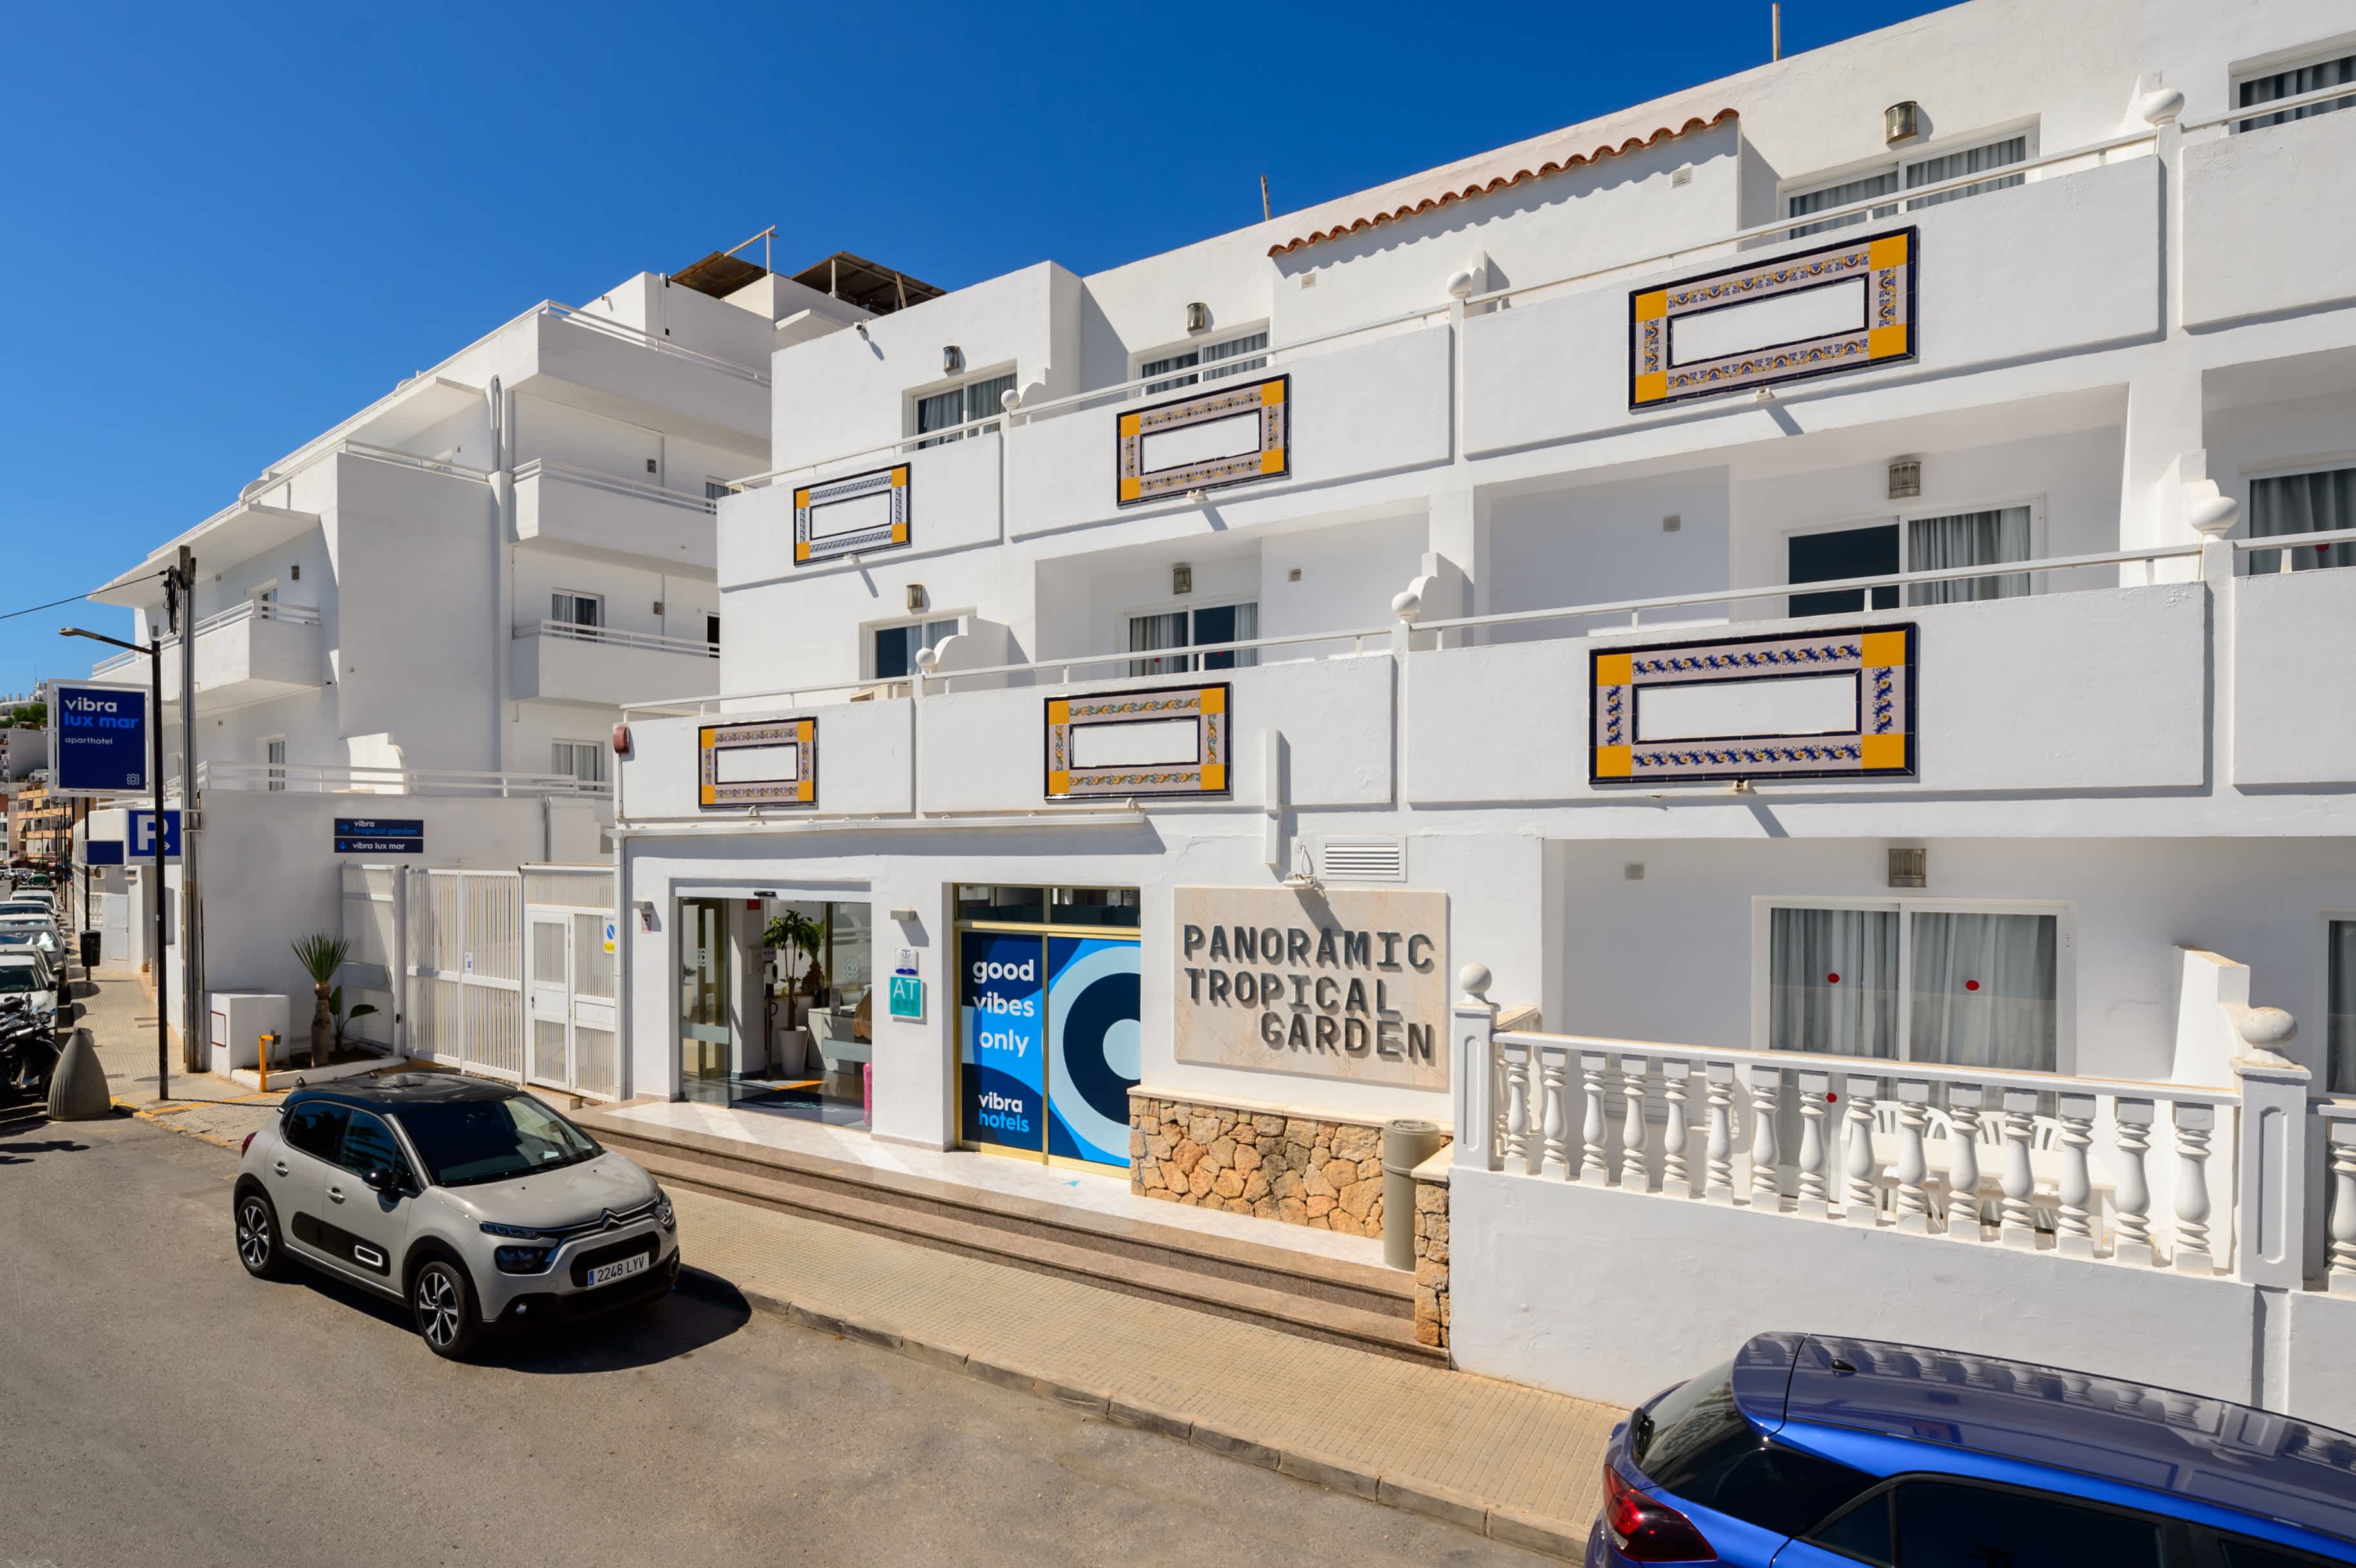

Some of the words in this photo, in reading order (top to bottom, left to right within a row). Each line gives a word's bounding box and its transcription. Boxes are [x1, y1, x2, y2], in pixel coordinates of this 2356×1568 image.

[64, 697, 117, 712] vibra
[64, 711, 93, 727] lux
[99, 716, 139, 729] mar
[137, 814, 169, 850] P
[1183, 924, 1435, 968] PANORAMIC
[973, 959, 1034, 984] good
[893, 979, 919, 1000] AT
[1184, 967, 1401, 1015] TROPICAL
[972, 991, 1035, 1017] vibes
[979, 1029, 1030, 1057] only
[1261, 1010, 1432, 1059] GARDEN
[979, 1091, 1022, 1113] vibra
[979, 1109, 1030, 1133] hotels
[597, 1263, 623, 1283] 2248
[626, 1256, 645, 1274] LYV
